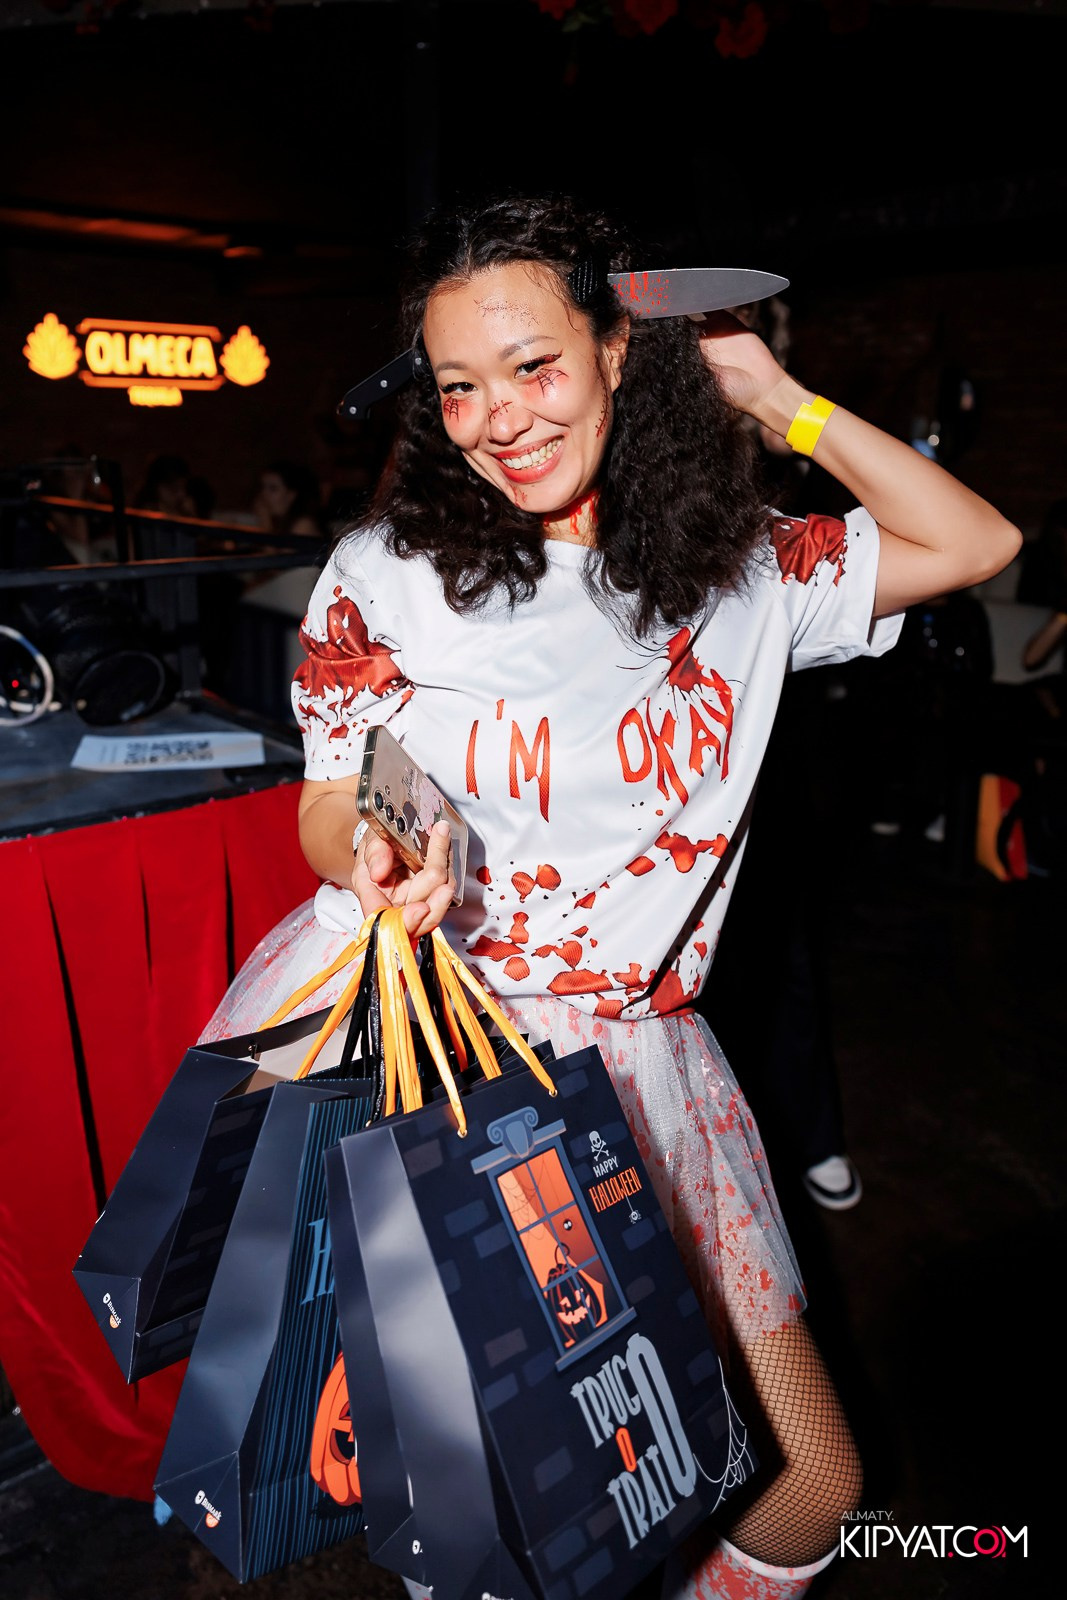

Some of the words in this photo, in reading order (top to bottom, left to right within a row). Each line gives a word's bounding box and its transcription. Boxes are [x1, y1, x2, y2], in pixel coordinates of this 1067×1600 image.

[85, 330, 217, 378] OLMECA
[466, 699, 550, 823] I'M
[617, 668, 734, 808] OKAY
[588, 1166, 642, 1213] HALLOWEEN
[593, 1156, 619, 1178] HAPPY
[616, 1427, 637, 1473] O
